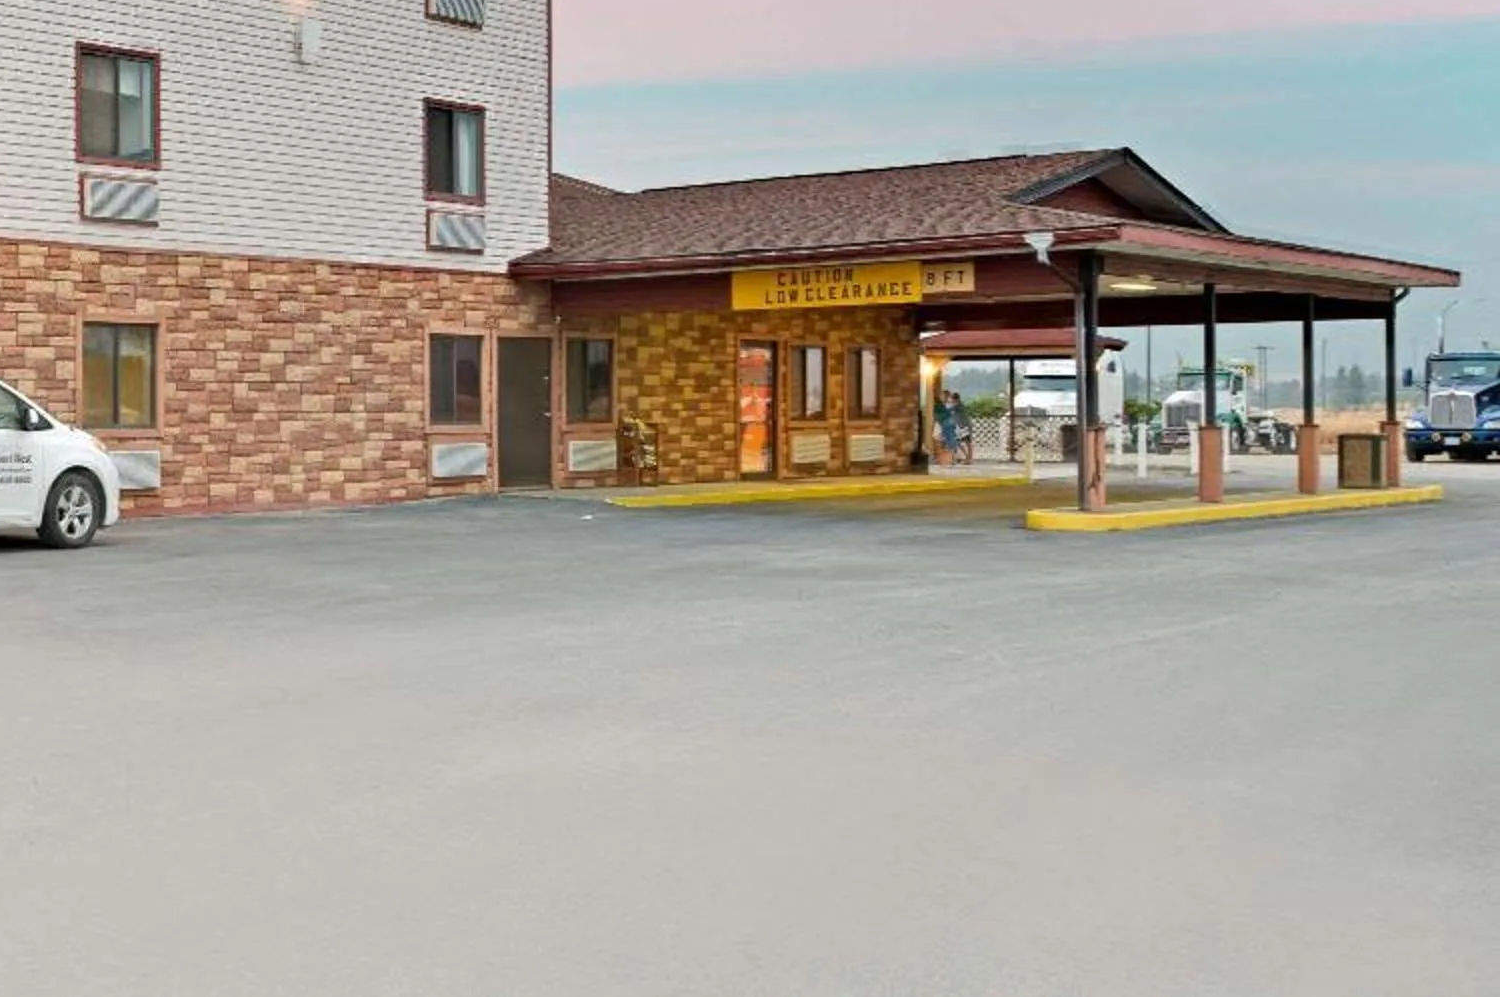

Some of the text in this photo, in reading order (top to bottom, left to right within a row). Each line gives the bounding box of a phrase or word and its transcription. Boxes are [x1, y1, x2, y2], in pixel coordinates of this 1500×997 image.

[777, 268, 854, 287] CAUTION
[943, 270, 965, 285] FT
[764, 289, 798, 305] LOW
